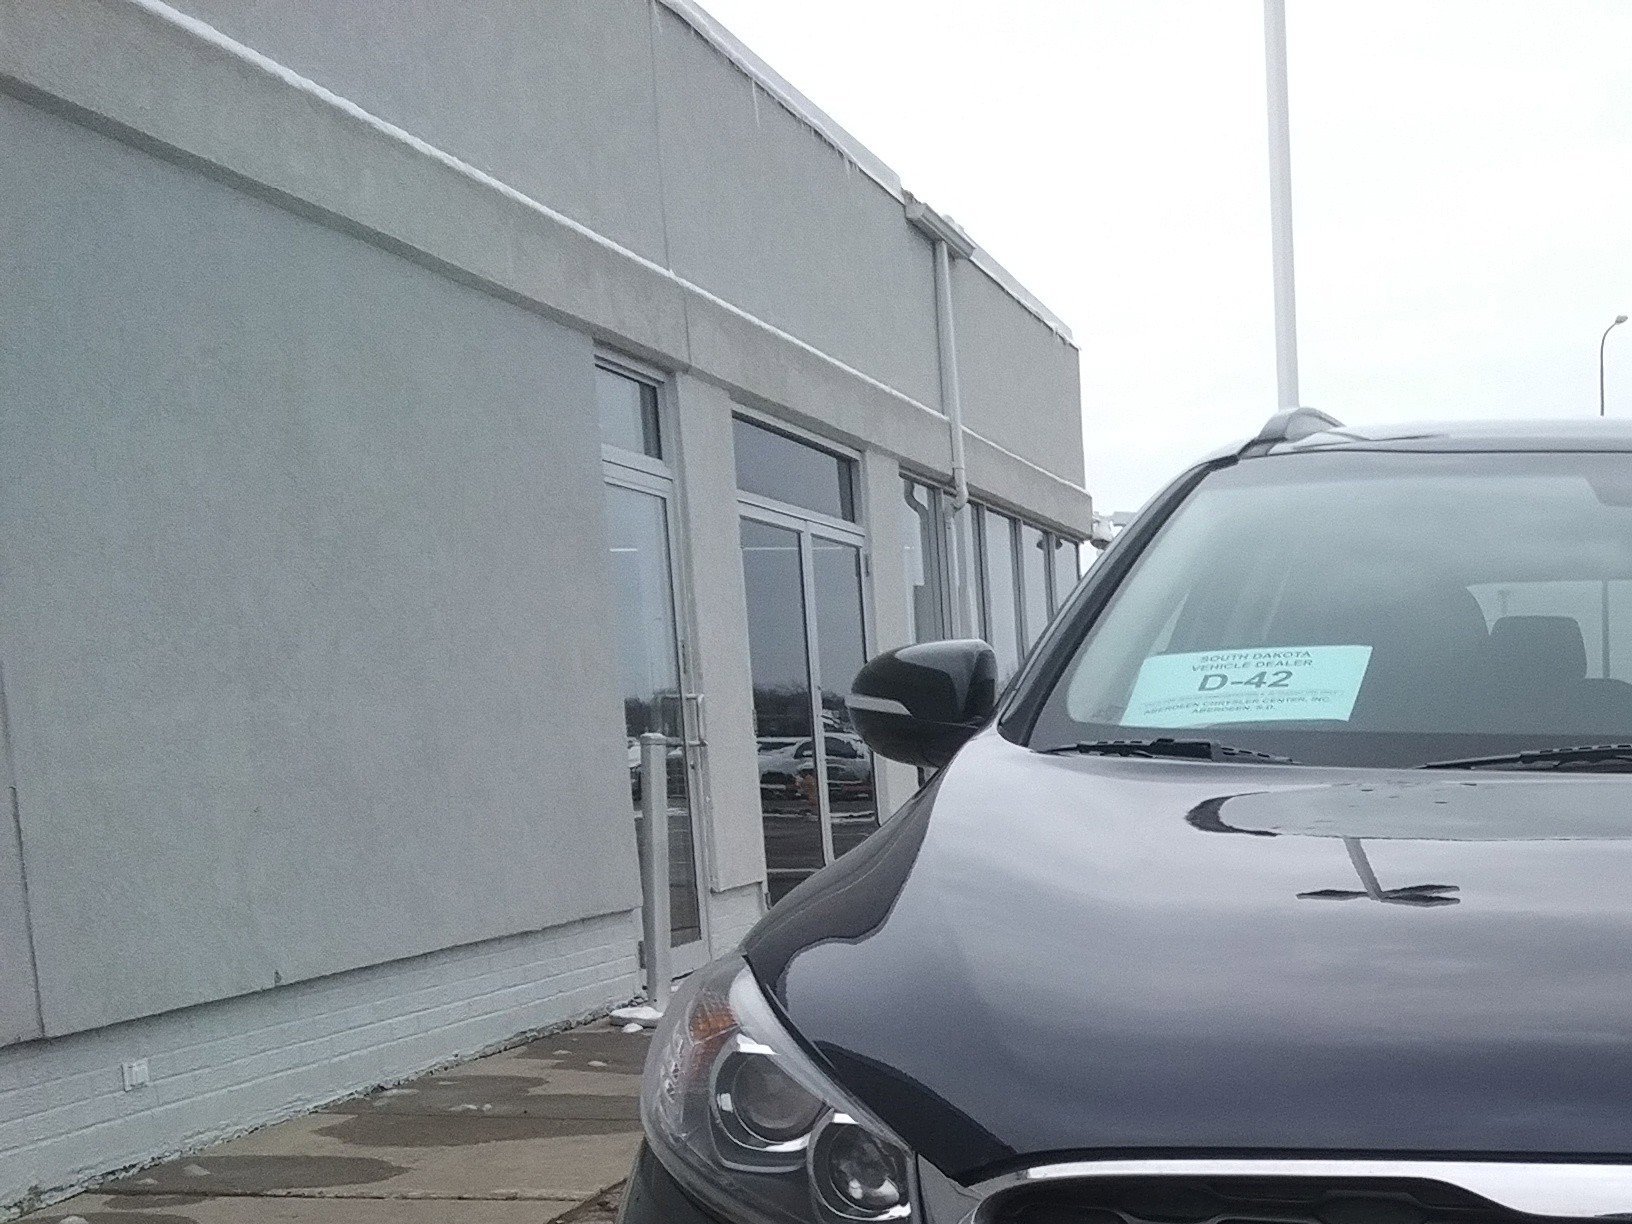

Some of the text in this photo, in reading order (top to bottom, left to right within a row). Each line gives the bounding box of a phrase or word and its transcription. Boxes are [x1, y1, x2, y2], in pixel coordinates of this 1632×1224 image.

[1201, 650, 1311, 662] SOUTH DAKOTA
[1192, 659, 1313, 672] VEHICLE DEALER
[1198, 670, 1293, 691] D-42
